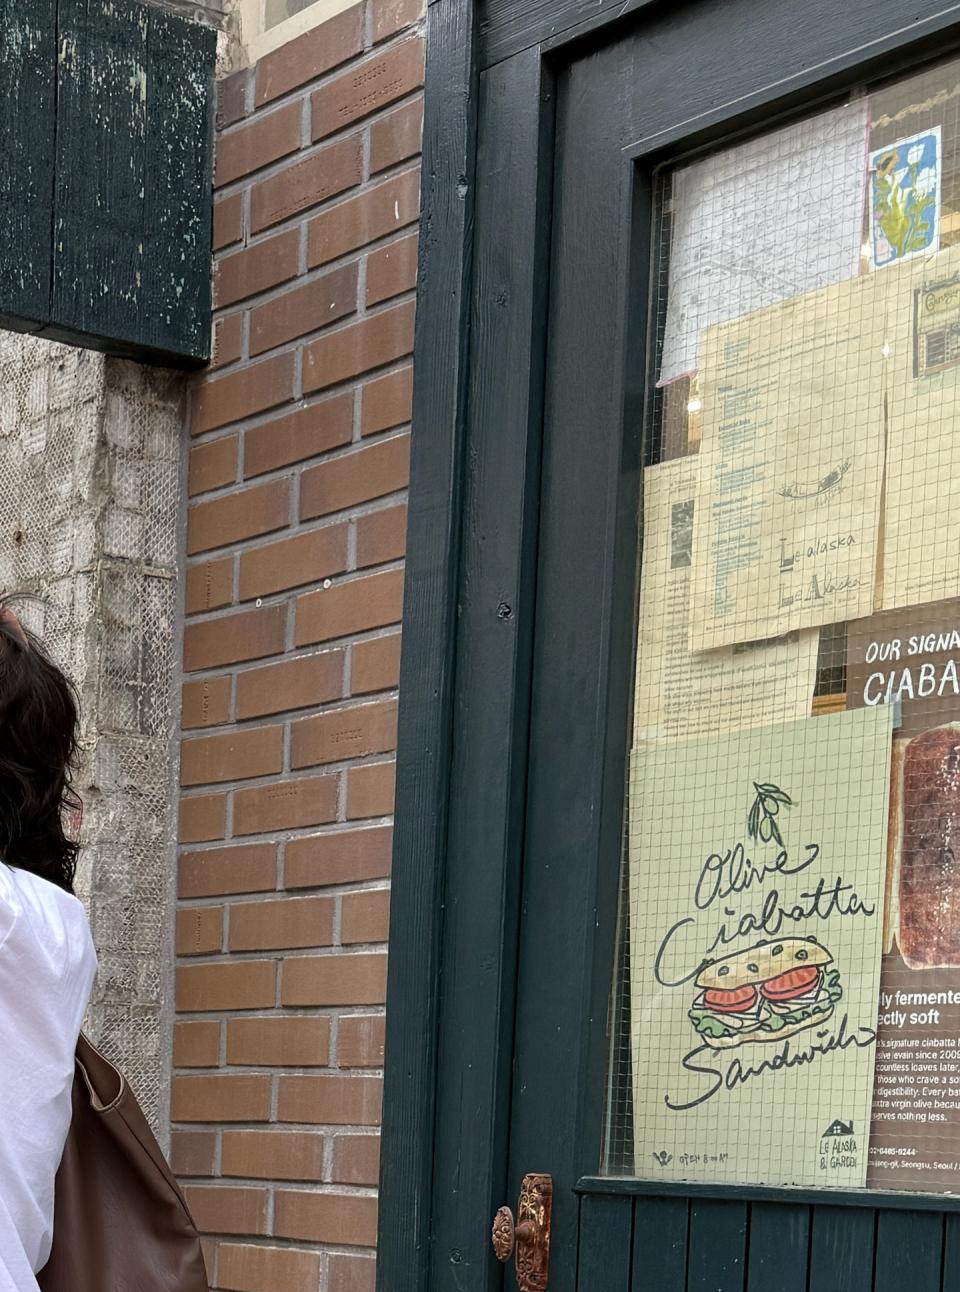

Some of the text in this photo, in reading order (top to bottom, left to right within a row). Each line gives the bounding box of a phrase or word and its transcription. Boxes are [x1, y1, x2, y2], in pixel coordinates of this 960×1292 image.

[807, 534, 856, 558] alaska
[865, 629, 960, 664] OUR SIGNA
[863, 659, 960, 706] CIABA
[695, 842, 820, 910] Olive
[654, 876, 875, 988] Ciabatta
[895, 990, 960, 1006] fermente
[909, 1008, 940, 1024] soft
[886, 1038, 920, 1049] signature
[921, 1037, 956, 1048] ciabatta
[664, 1012, 876, 1111] Sandwich
[915, 1051, 938, 1060] since
[898, 1075, 915, 1084] who
[916, 1076, 939, 1084] crave
[922, 1087, 946, 1098] Every
[913, 1099, 932, 1108] olive
[897, 1112, 927, 1122] nothng
